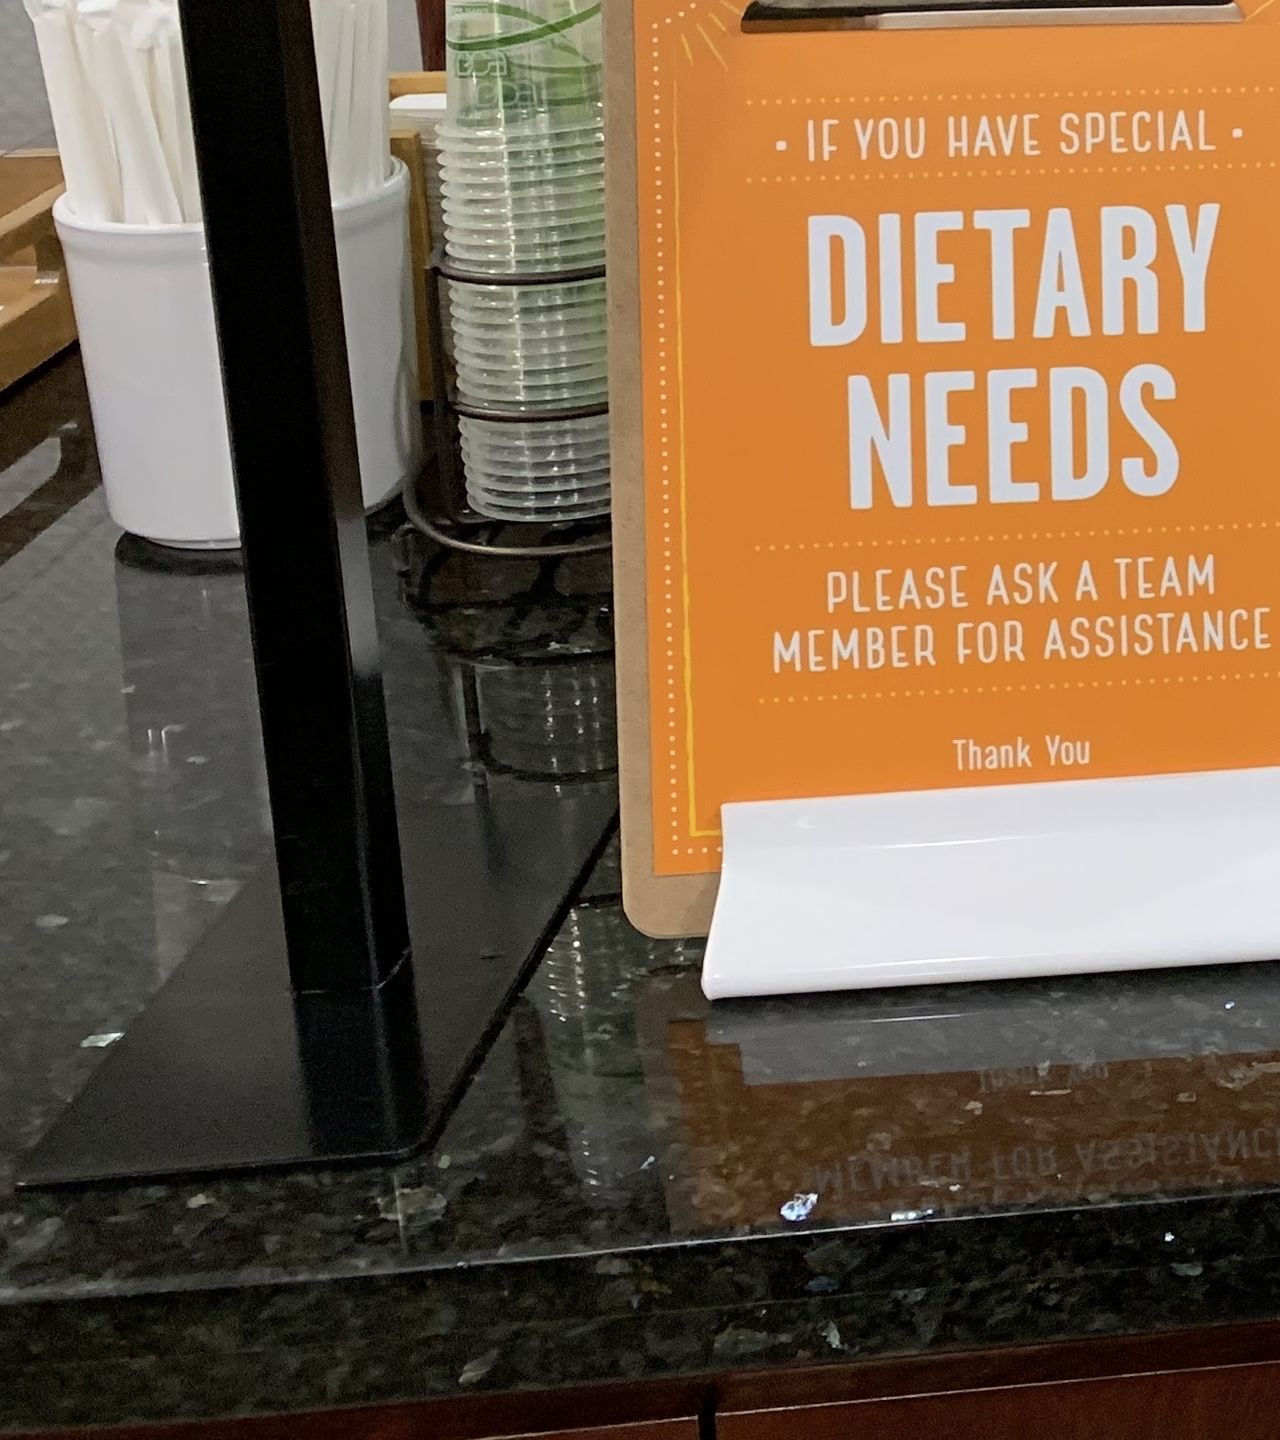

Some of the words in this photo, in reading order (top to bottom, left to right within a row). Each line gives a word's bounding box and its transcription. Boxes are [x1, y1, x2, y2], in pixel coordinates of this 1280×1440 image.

[806, 118, 840, 163] IF
[853, 116, 927, 161] YOU
[947, 113, 1042, 158] HAVE
[1059, 108, 1217, 156] SPECIAL
[806, 201, 1222, 348] DIETARY
[846, 362, 1181, 511] NEEDS
[826, 564, 969, 614] PLEASE
[986, 561, 1059, 606] ASK
[1074, 559, 1099, 602] A
[1113, 553, 1215, 600] TEAM
[772, 623, 937, 674] MEMBER
[956, 619, 1026, 665] FOR
[1043, 606, 1272, 660] ASSISTANCE
[952, 736, 1032, 771] Thank
[1044, 734, 1091, 766] You
